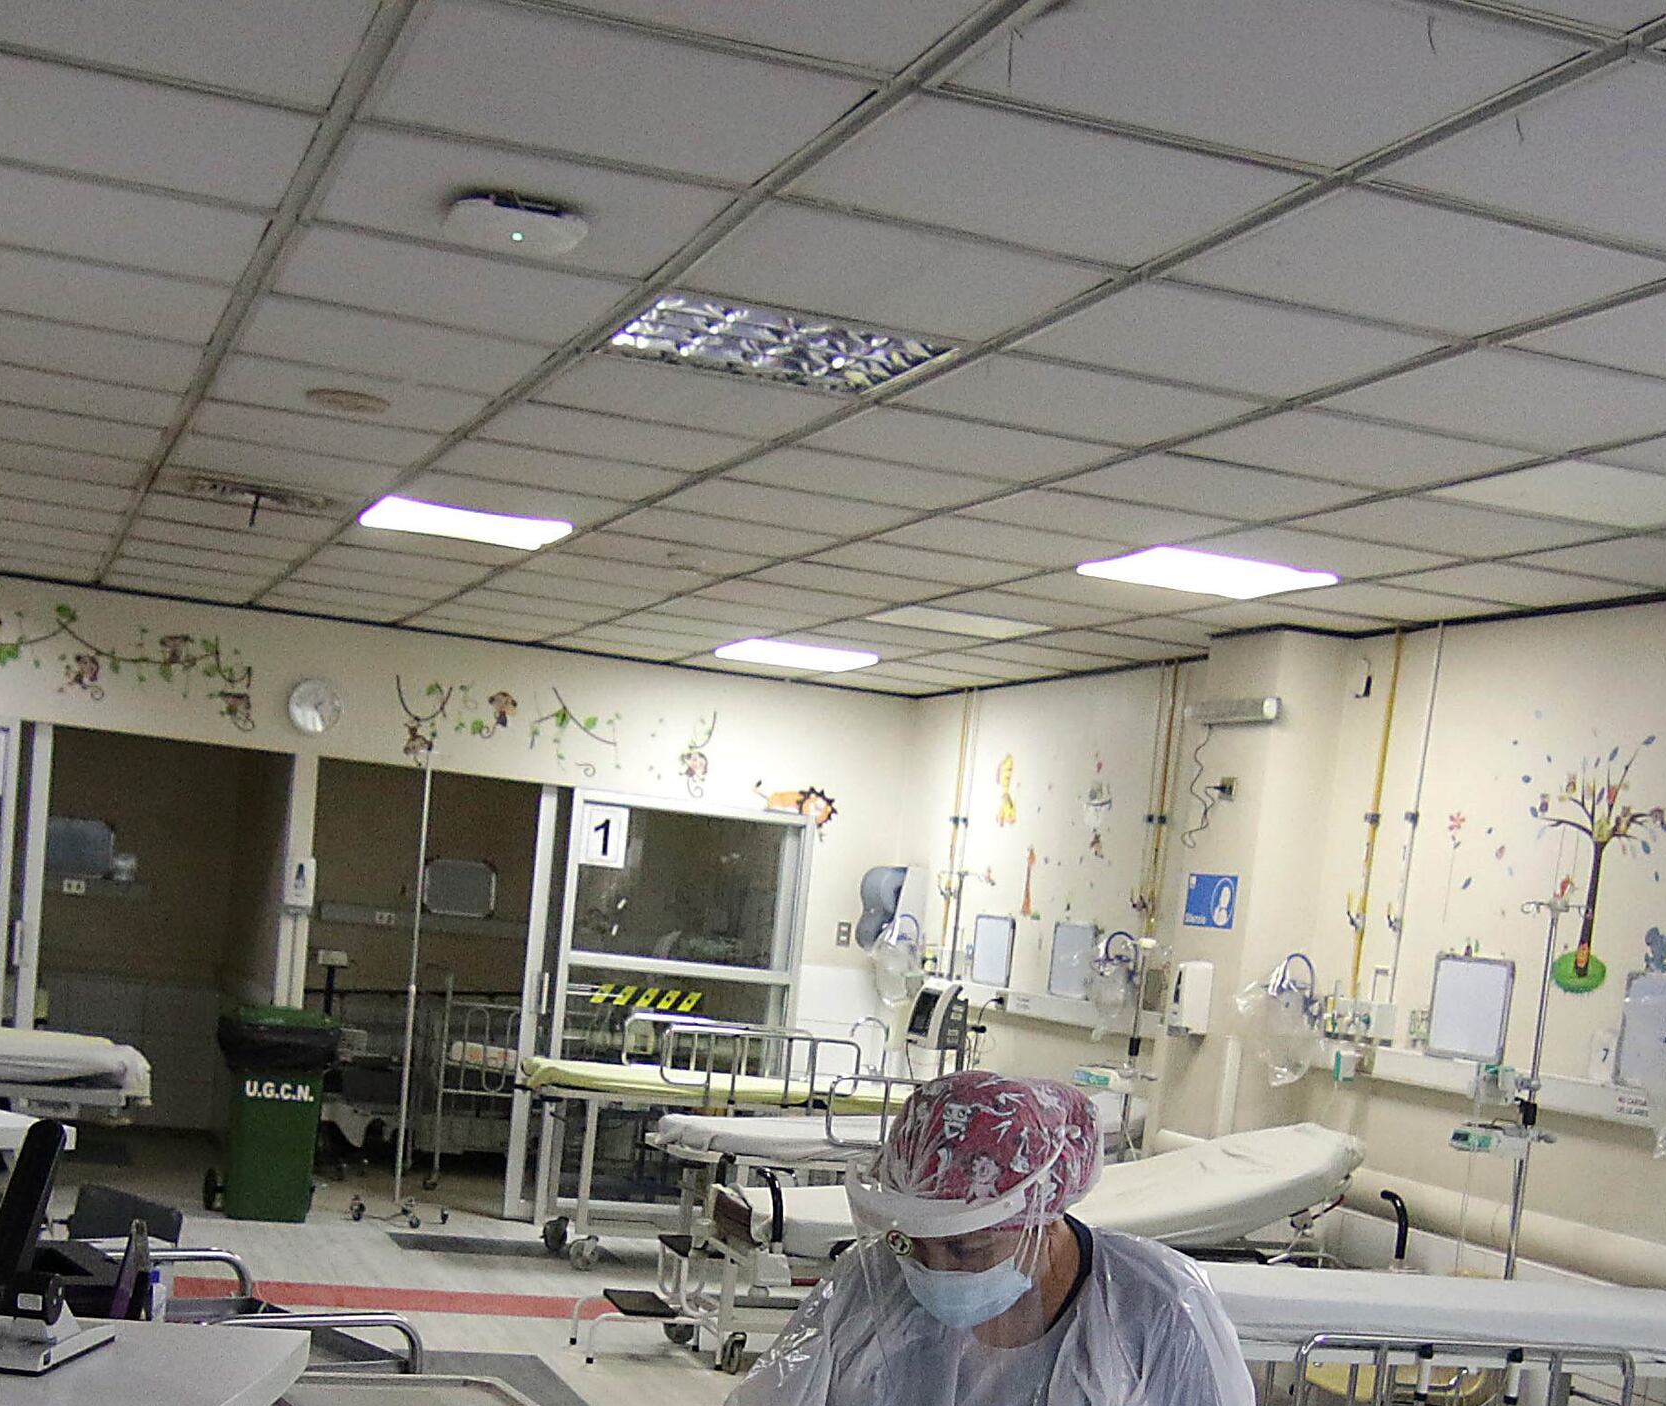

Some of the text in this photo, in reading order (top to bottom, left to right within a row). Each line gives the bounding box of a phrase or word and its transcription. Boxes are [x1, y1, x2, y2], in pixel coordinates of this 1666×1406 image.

[594, 819, 610, 856] 1
[1602, 1048, 1609, 1062] 7
[246, 1080, 314, 1102] U.G.C.N.
